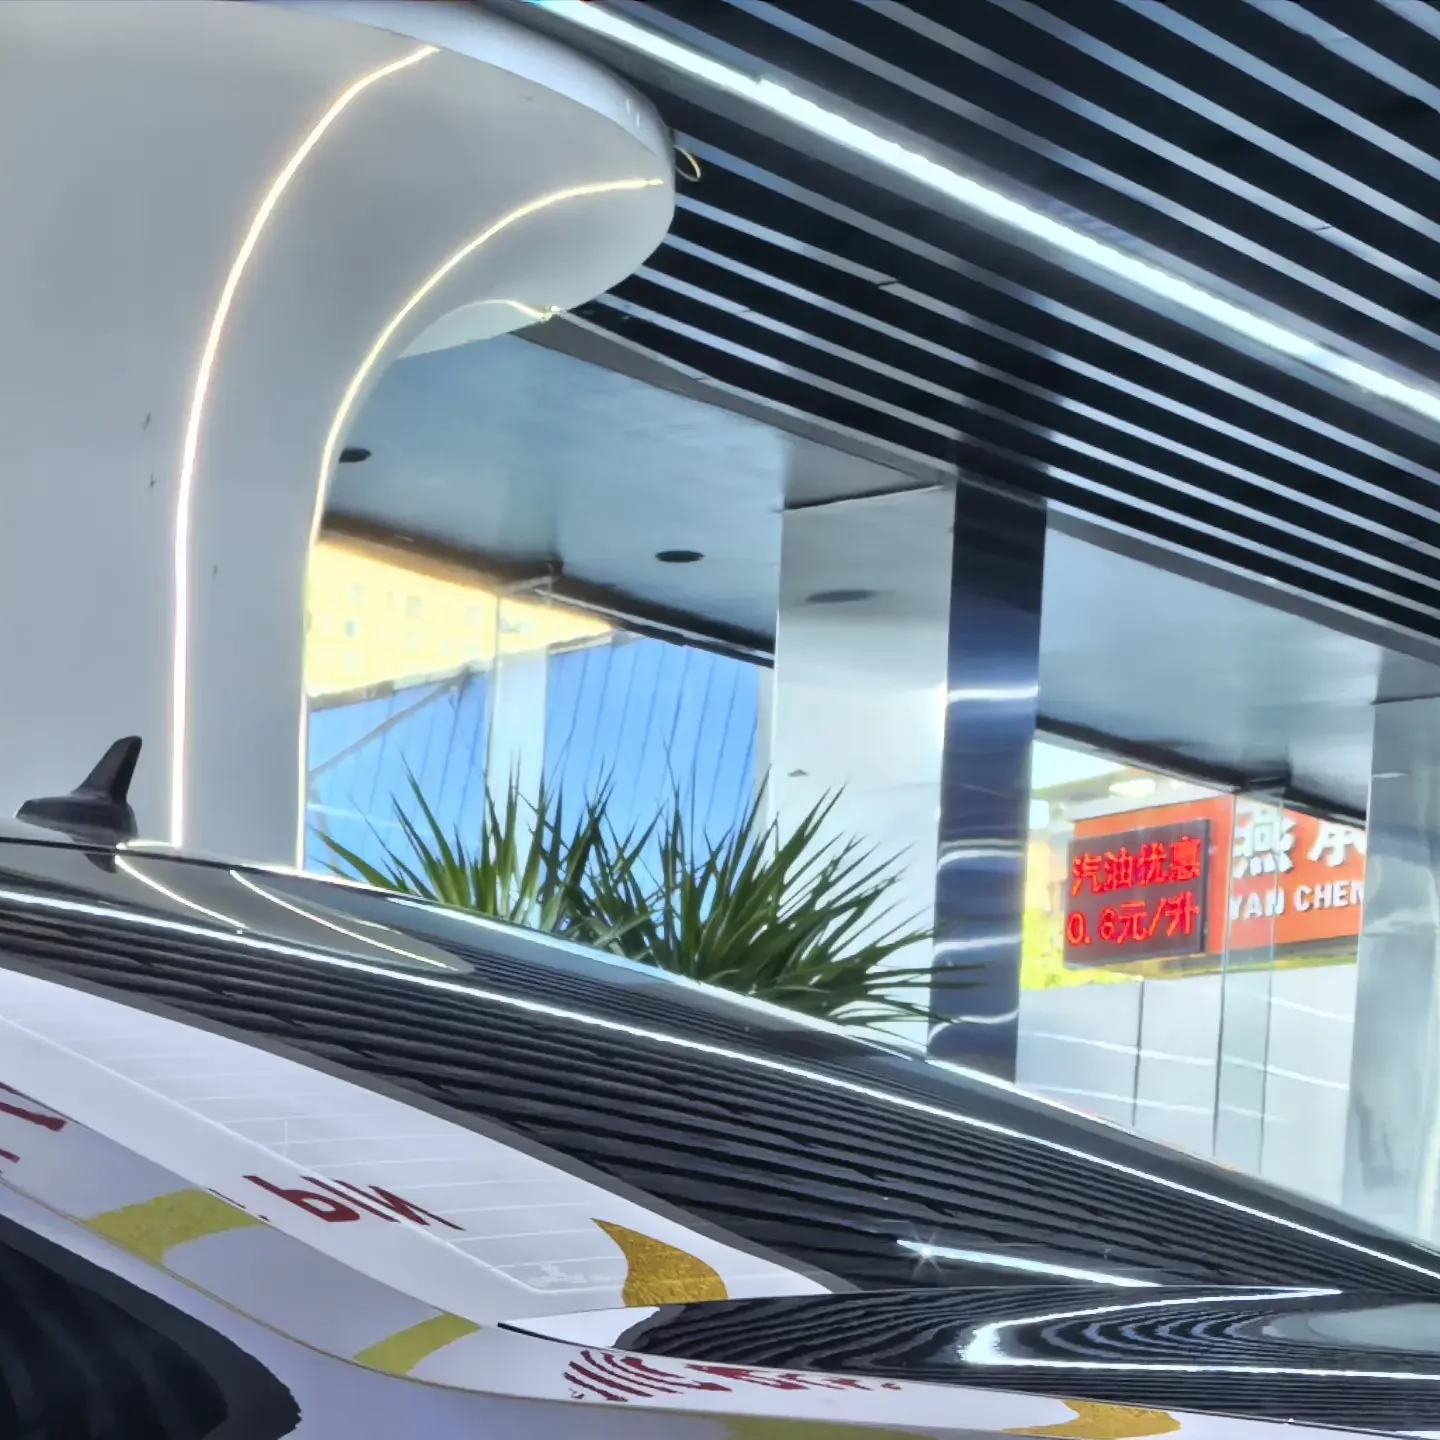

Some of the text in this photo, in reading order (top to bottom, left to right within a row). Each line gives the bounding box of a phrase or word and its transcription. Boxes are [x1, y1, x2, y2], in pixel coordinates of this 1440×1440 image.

[1072, 836, 1202, 896] 汽油优惠
[1229, 888, 1285, 921] YAN
